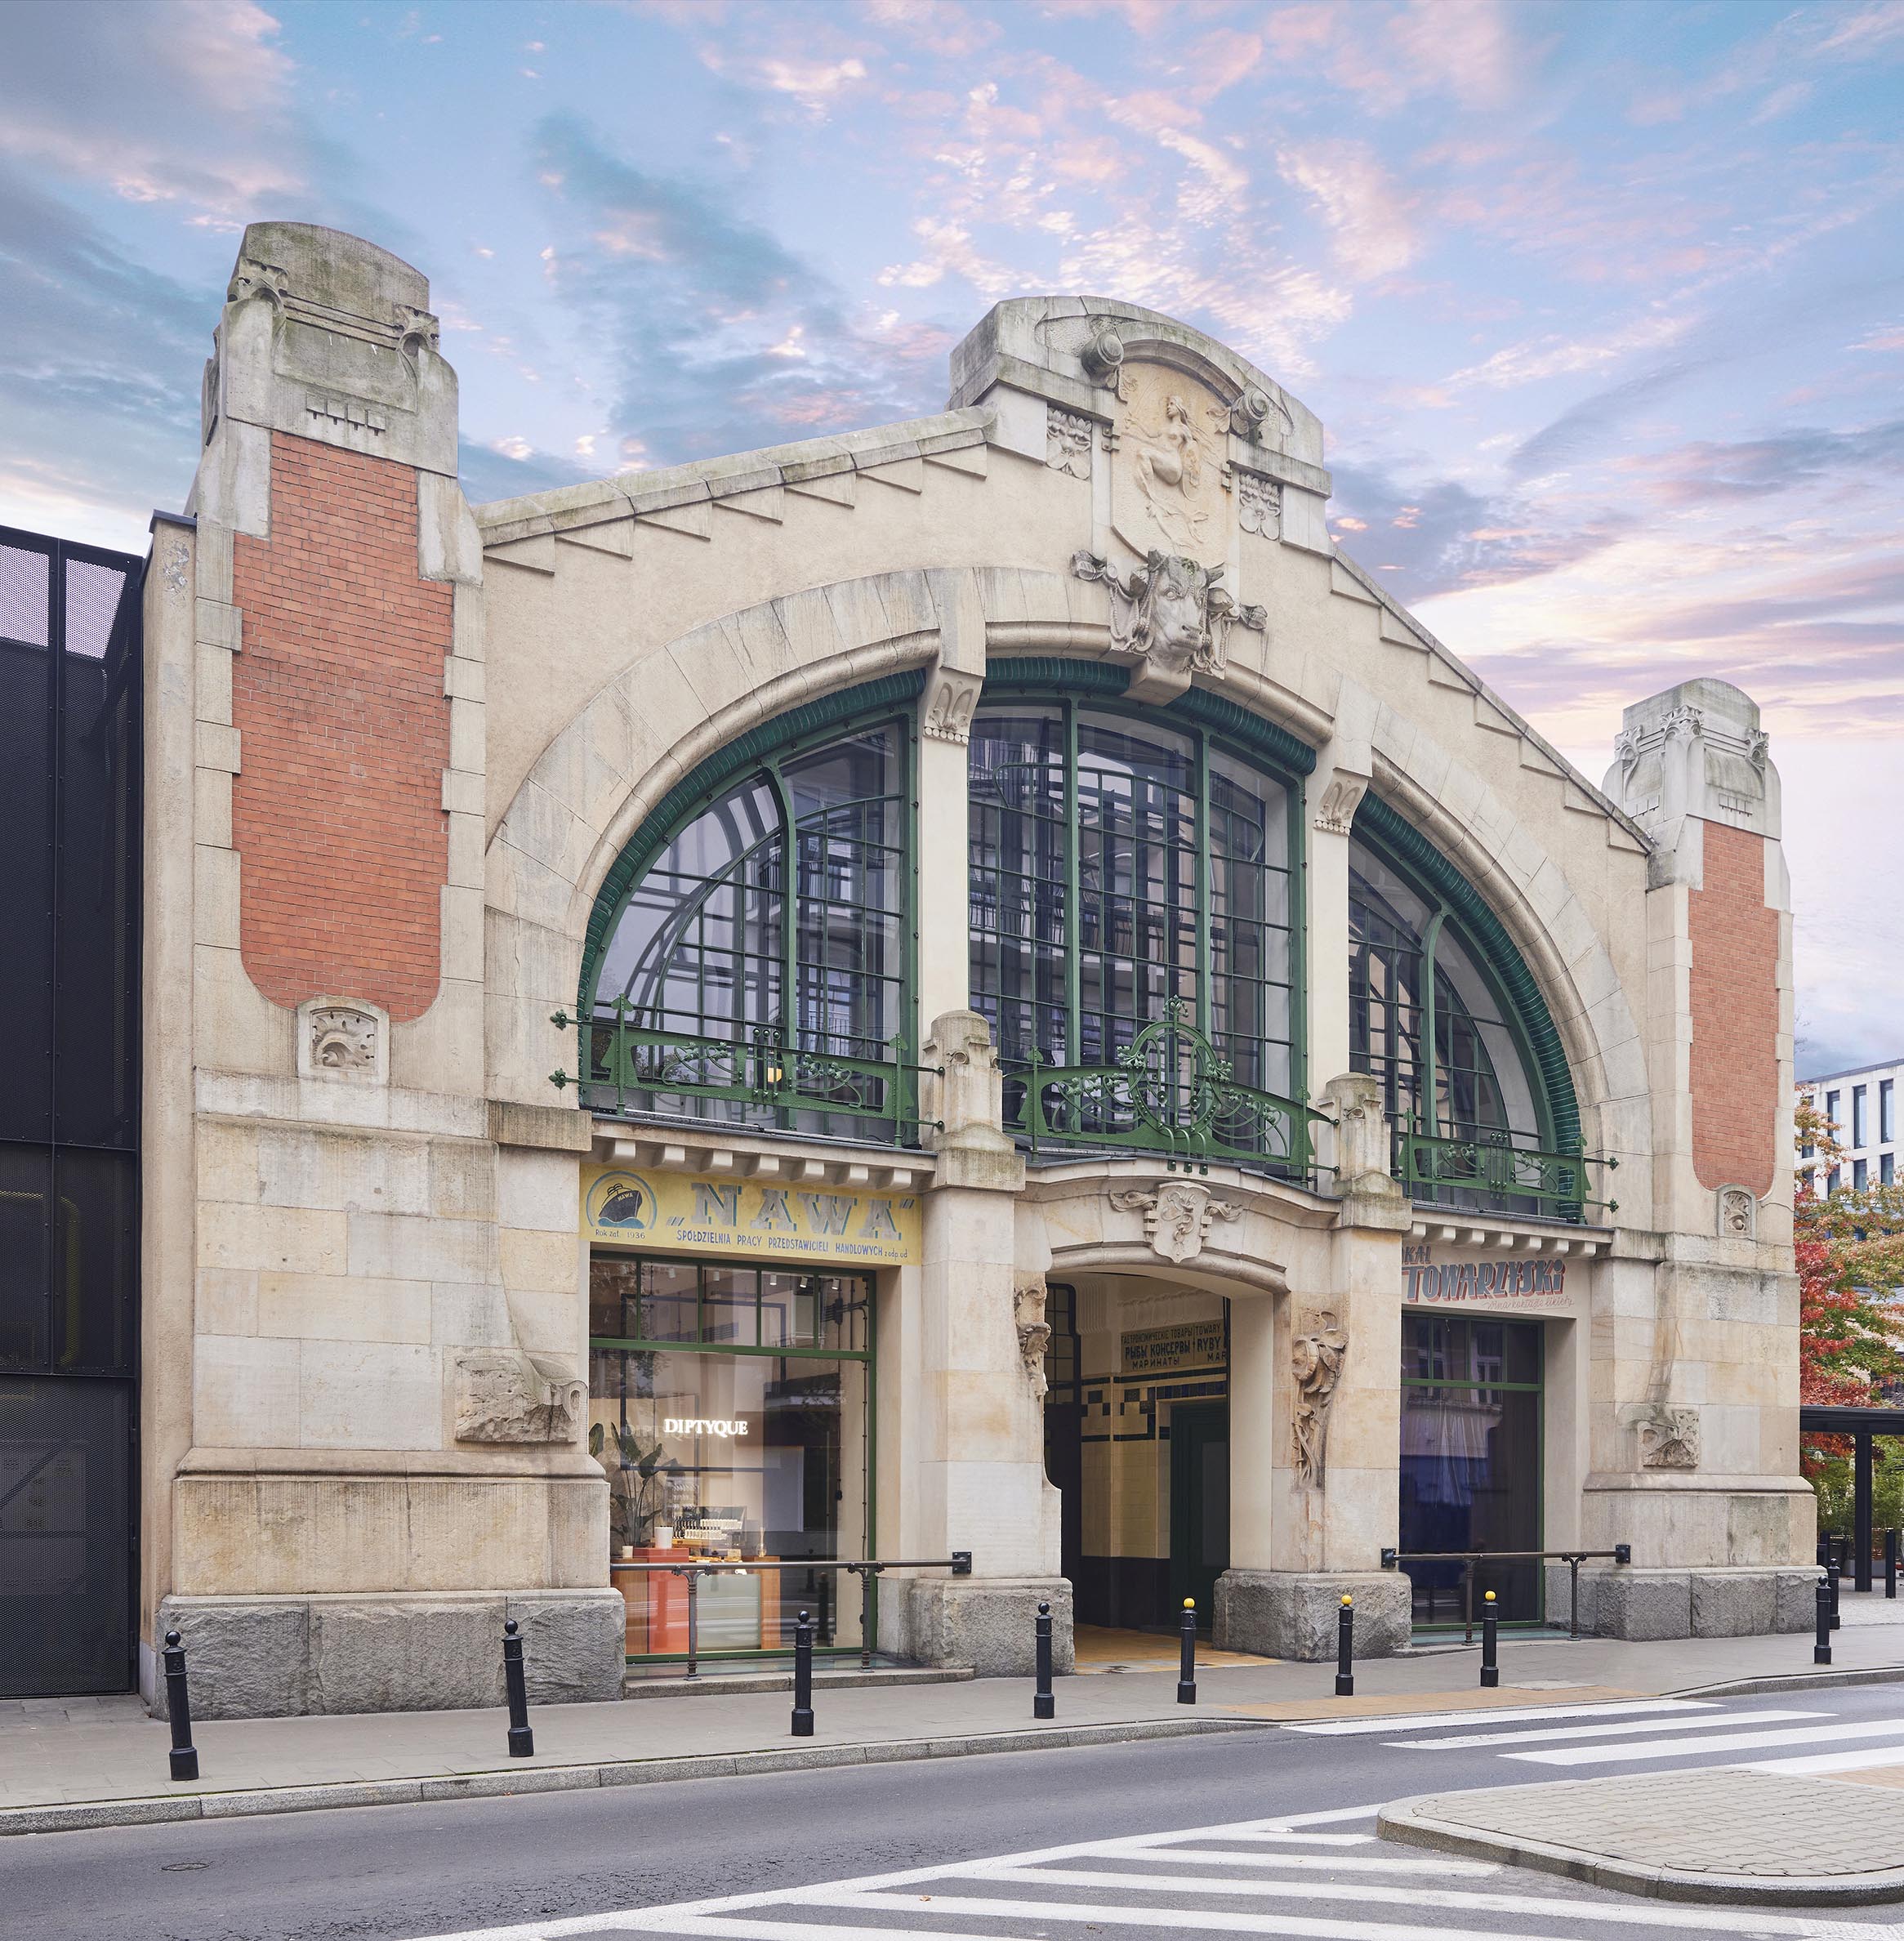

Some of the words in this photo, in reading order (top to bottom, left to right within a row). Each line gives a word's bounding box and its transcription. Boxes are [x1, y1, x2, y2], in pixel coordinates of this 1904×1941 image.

[618, 1193, 633, 1201] NAWA
[677, 1229, 731, 1244] SPÓŁDZIELNIA
[737, 1234, 762, 1247] PRACY
[768, 1237, 829, 1252] PRZEDSTAWICIELI
[835, 1243, 883, 1256] HANDLOWYCH
[1402, 1246, 1432, 1265] KAL
[1195, 1323, 1221, 1336] TOWARY
[1197, 1336, 1220, 1352] RYBY
[664, 1418, 748, 1438] DIPTYQUE
